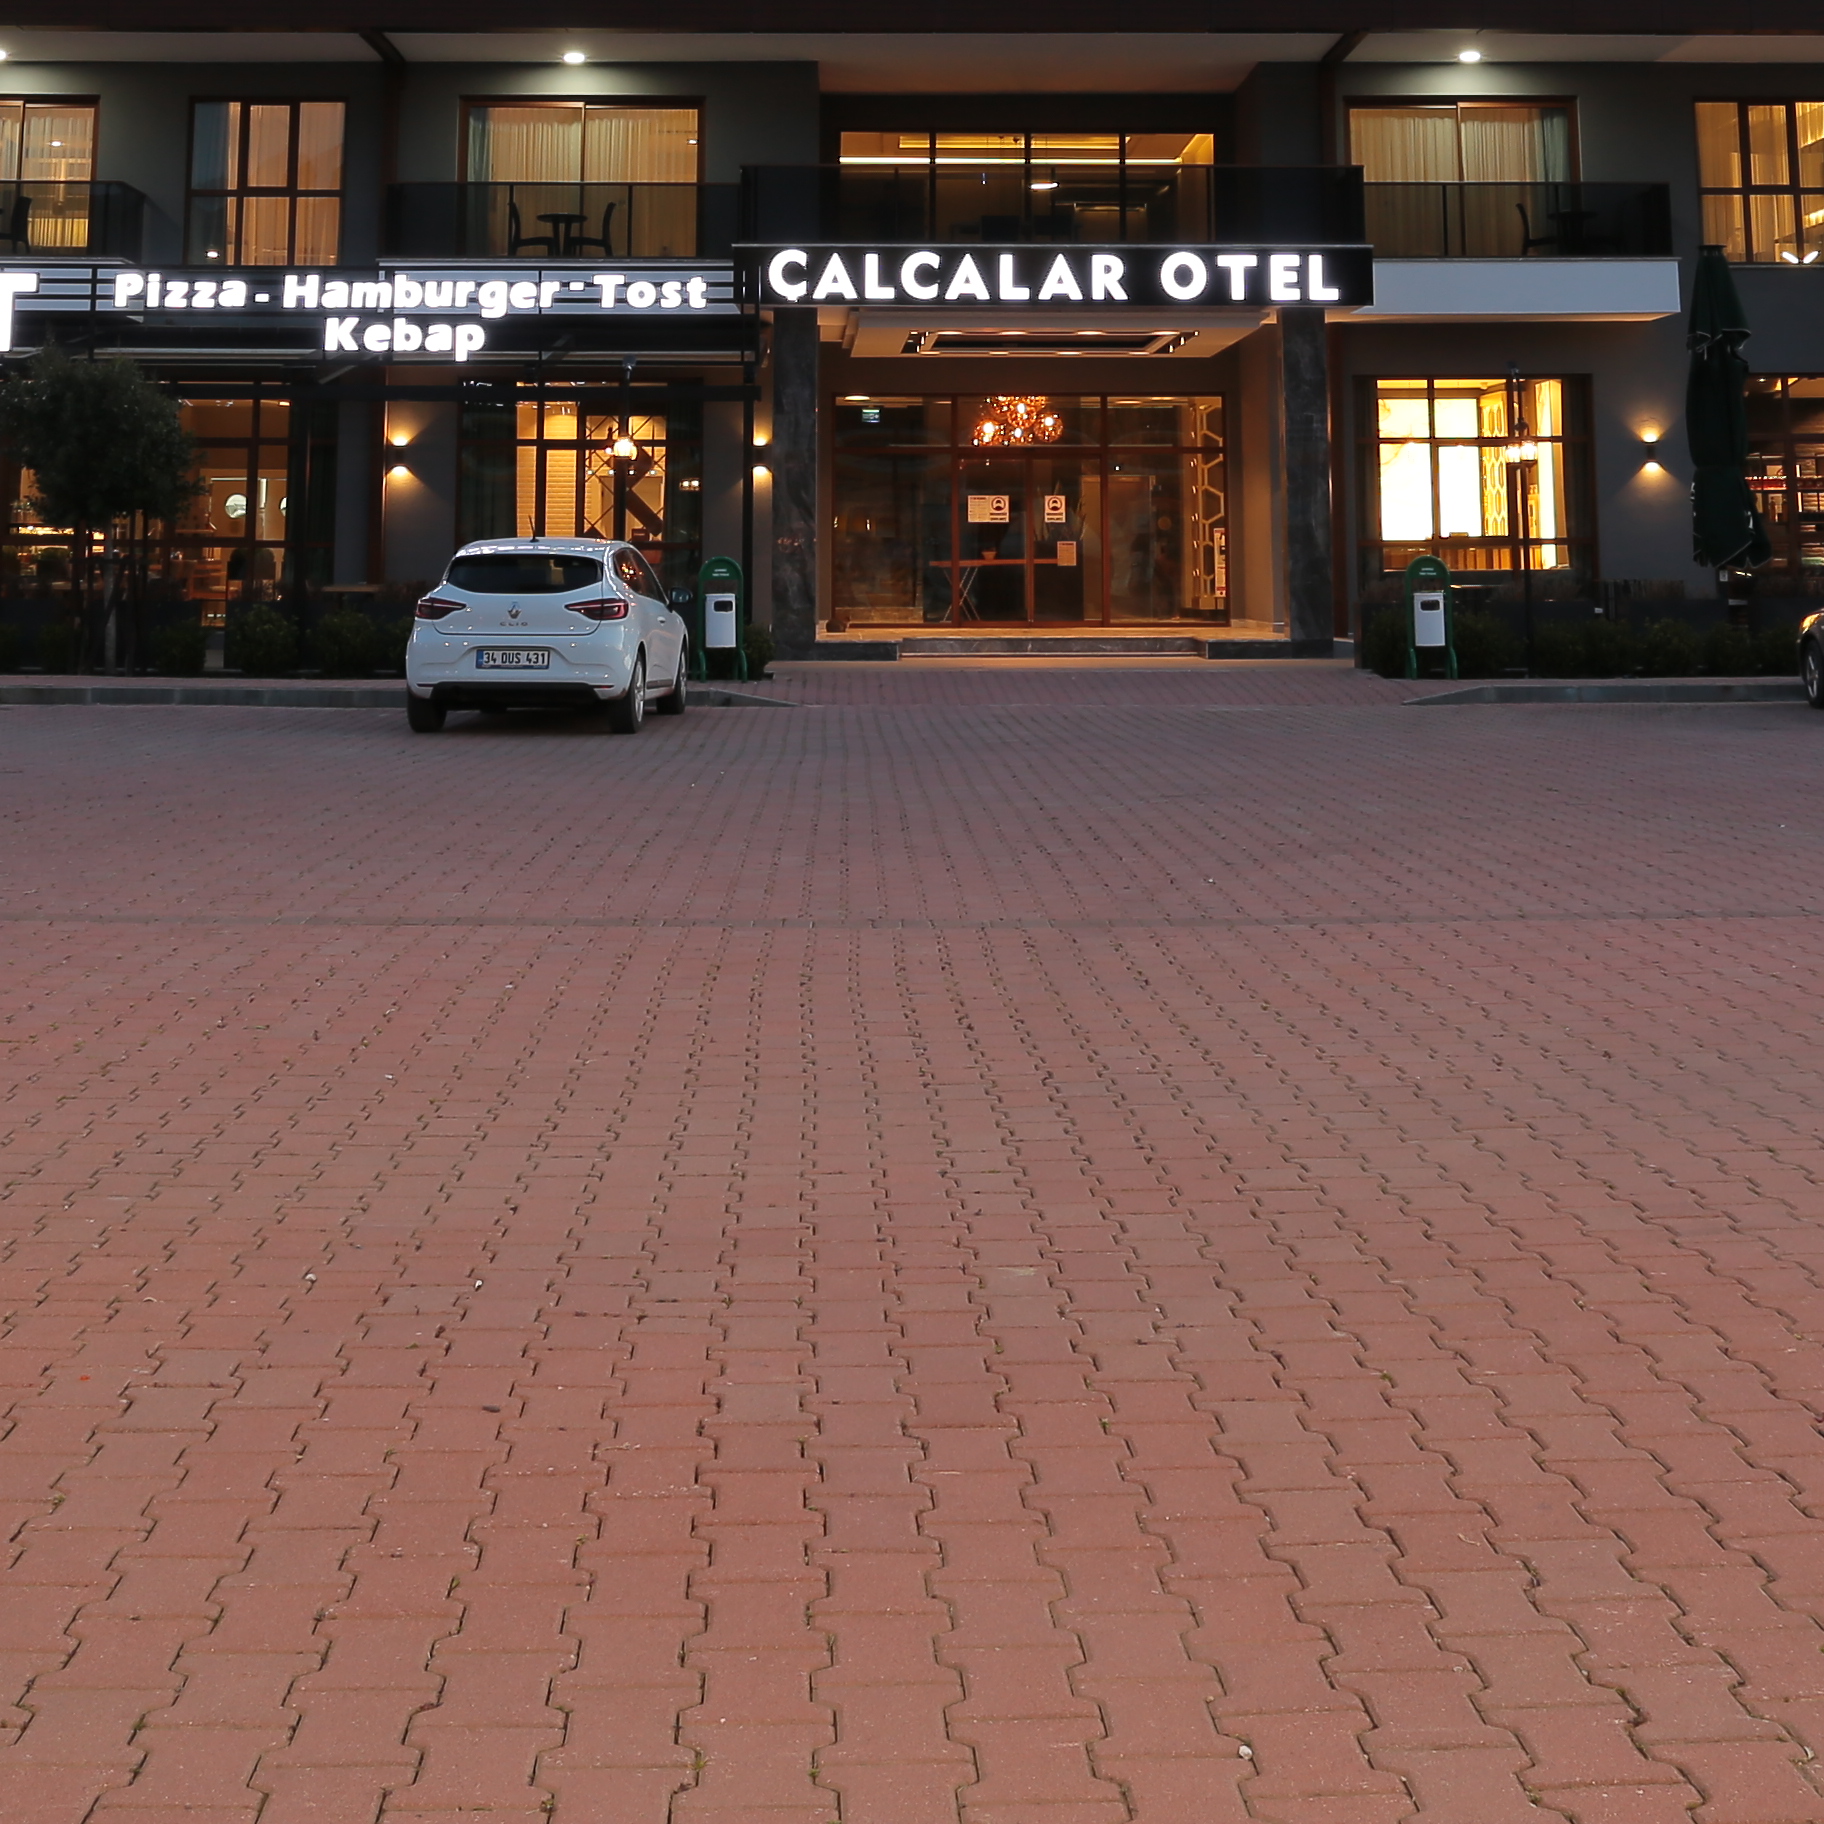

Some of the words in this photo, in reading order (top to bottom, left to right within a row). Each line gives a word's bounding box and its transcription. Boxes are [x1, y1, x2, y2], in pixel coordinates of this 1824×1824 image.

[113, 272, 248, 309] Pizza
[283, 273, 561, 320] Hamburger
[592, 274, 708, 310] Tost
[767, 249, 1129, 303] ÇALCALAR
[1160, 251, 1340, 302] OTEL
[323, 316, 486, 363] Kebap
[483, 651, 497, 664] 34
[525, 651, 546, 664] 431
